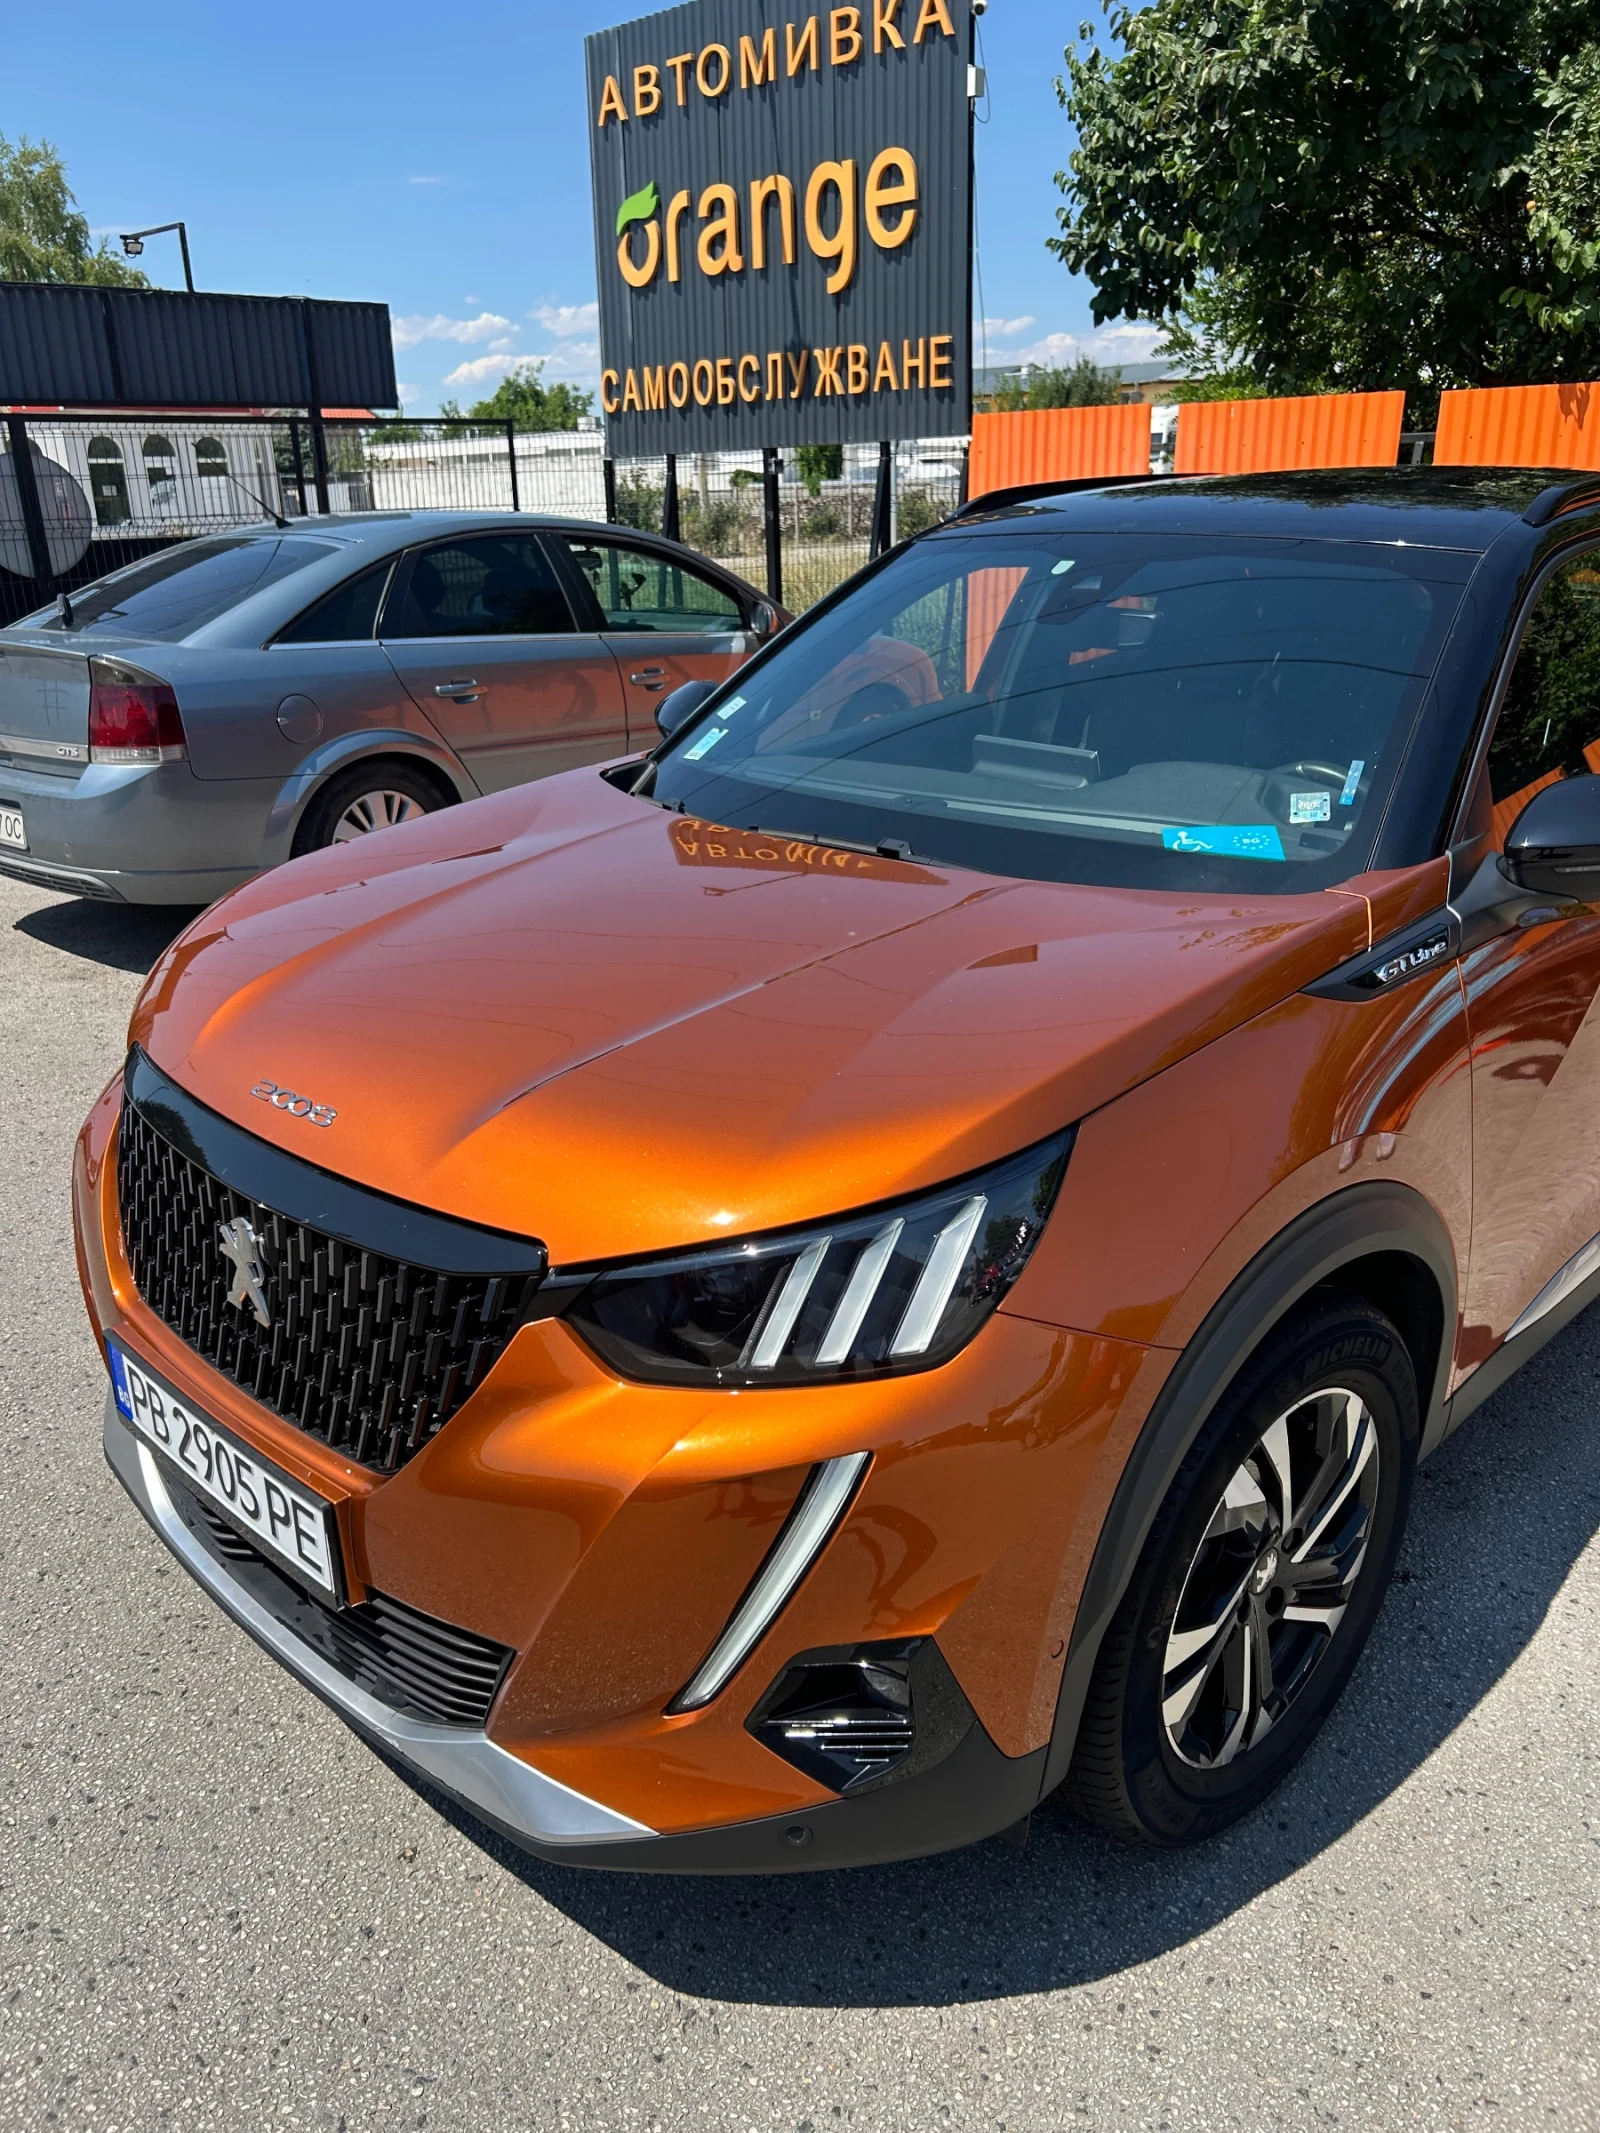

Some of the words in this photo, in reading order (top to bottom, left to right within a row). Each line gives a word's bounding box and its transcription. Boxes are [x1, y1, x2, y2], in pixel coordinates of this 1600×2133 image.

[598, 0, 955, 126] АВТОМИВКА
[617, 147, 919, 295] orange
[602, 335, 953, 413] САМООБСЛУЖВАНЕ
[57, 746, 80, 758] GTS
[250, 1079, 338, 1127] 2008
[1303, 1337, 1390, 1379] MICHELIN
[117, 1385, 131, 1408] BG
